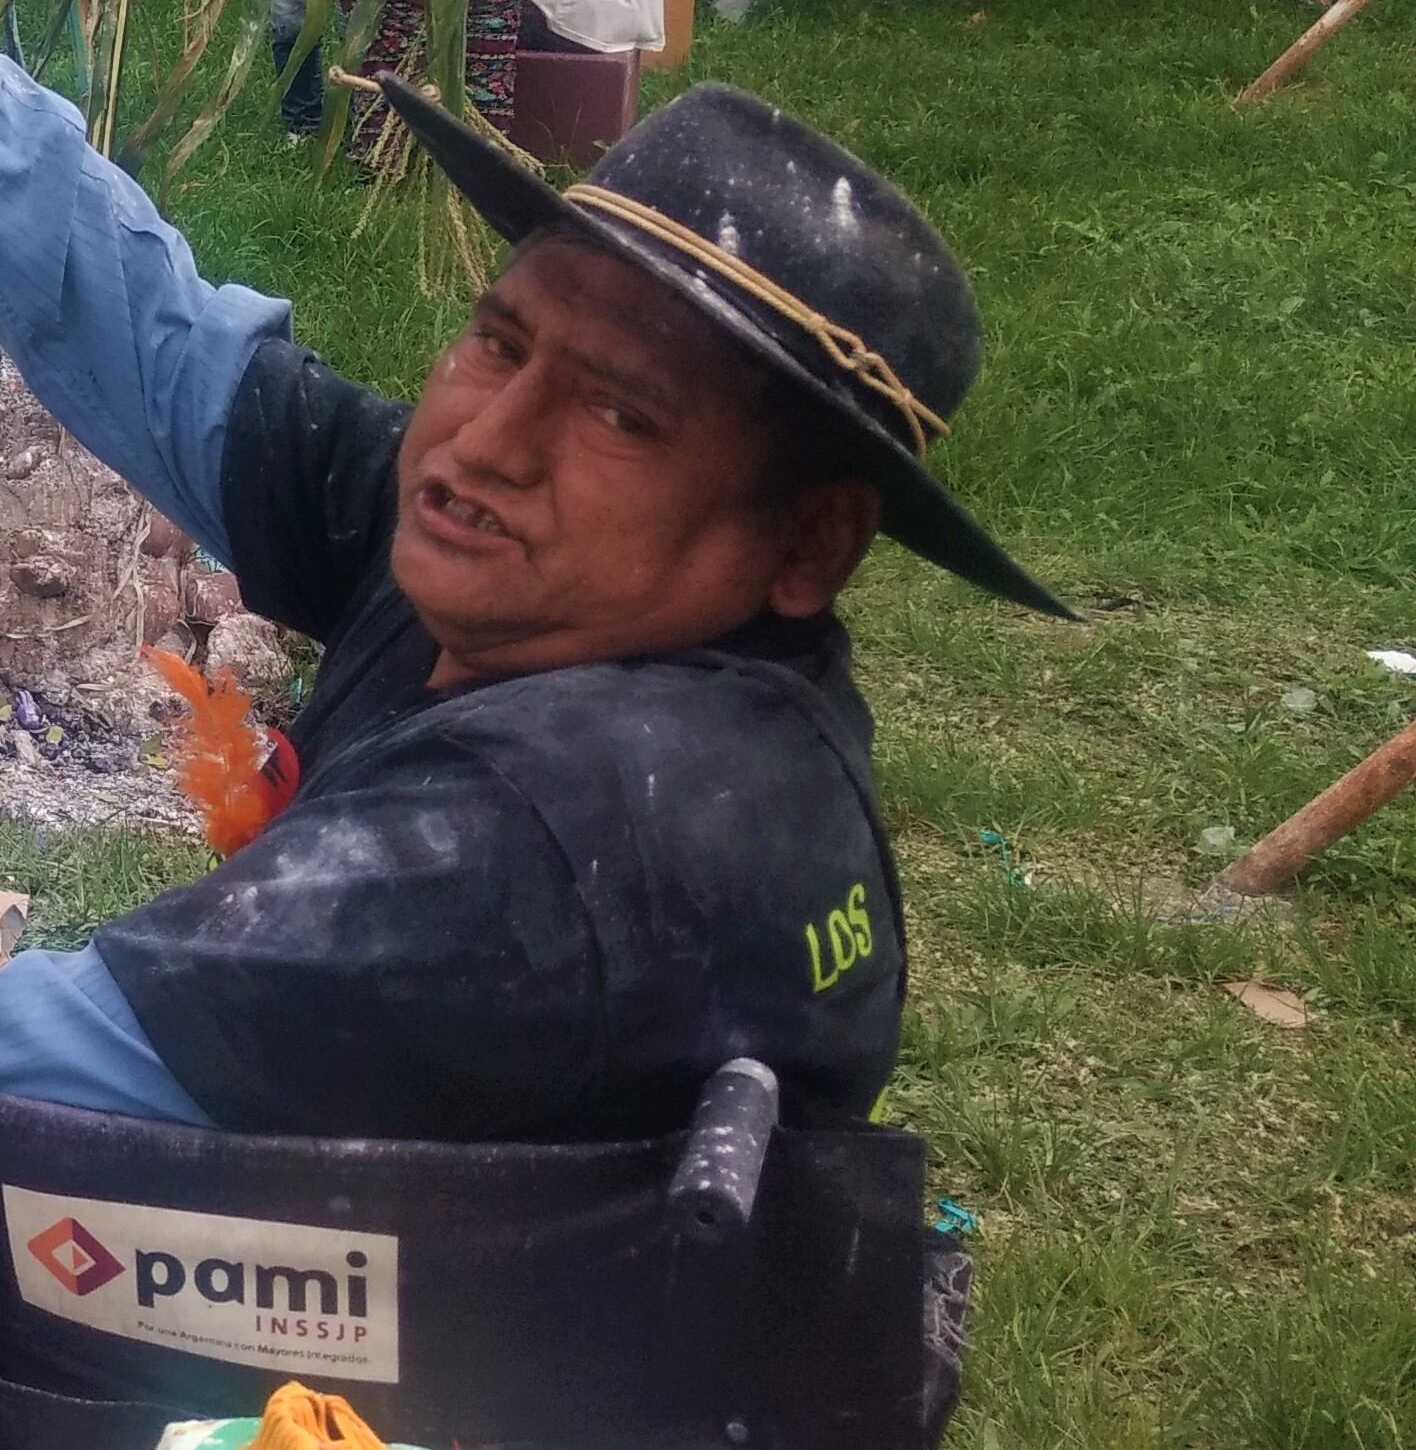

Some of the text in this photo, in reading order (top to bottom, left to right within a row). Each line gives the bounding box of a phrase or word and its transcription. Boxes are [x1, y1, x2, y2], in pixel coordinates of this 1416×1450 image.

[805, 883, 872, 992] LOS
[134, 1248, 368, 1318] pami
[255, 1314, 368, 1344] INSSJP
